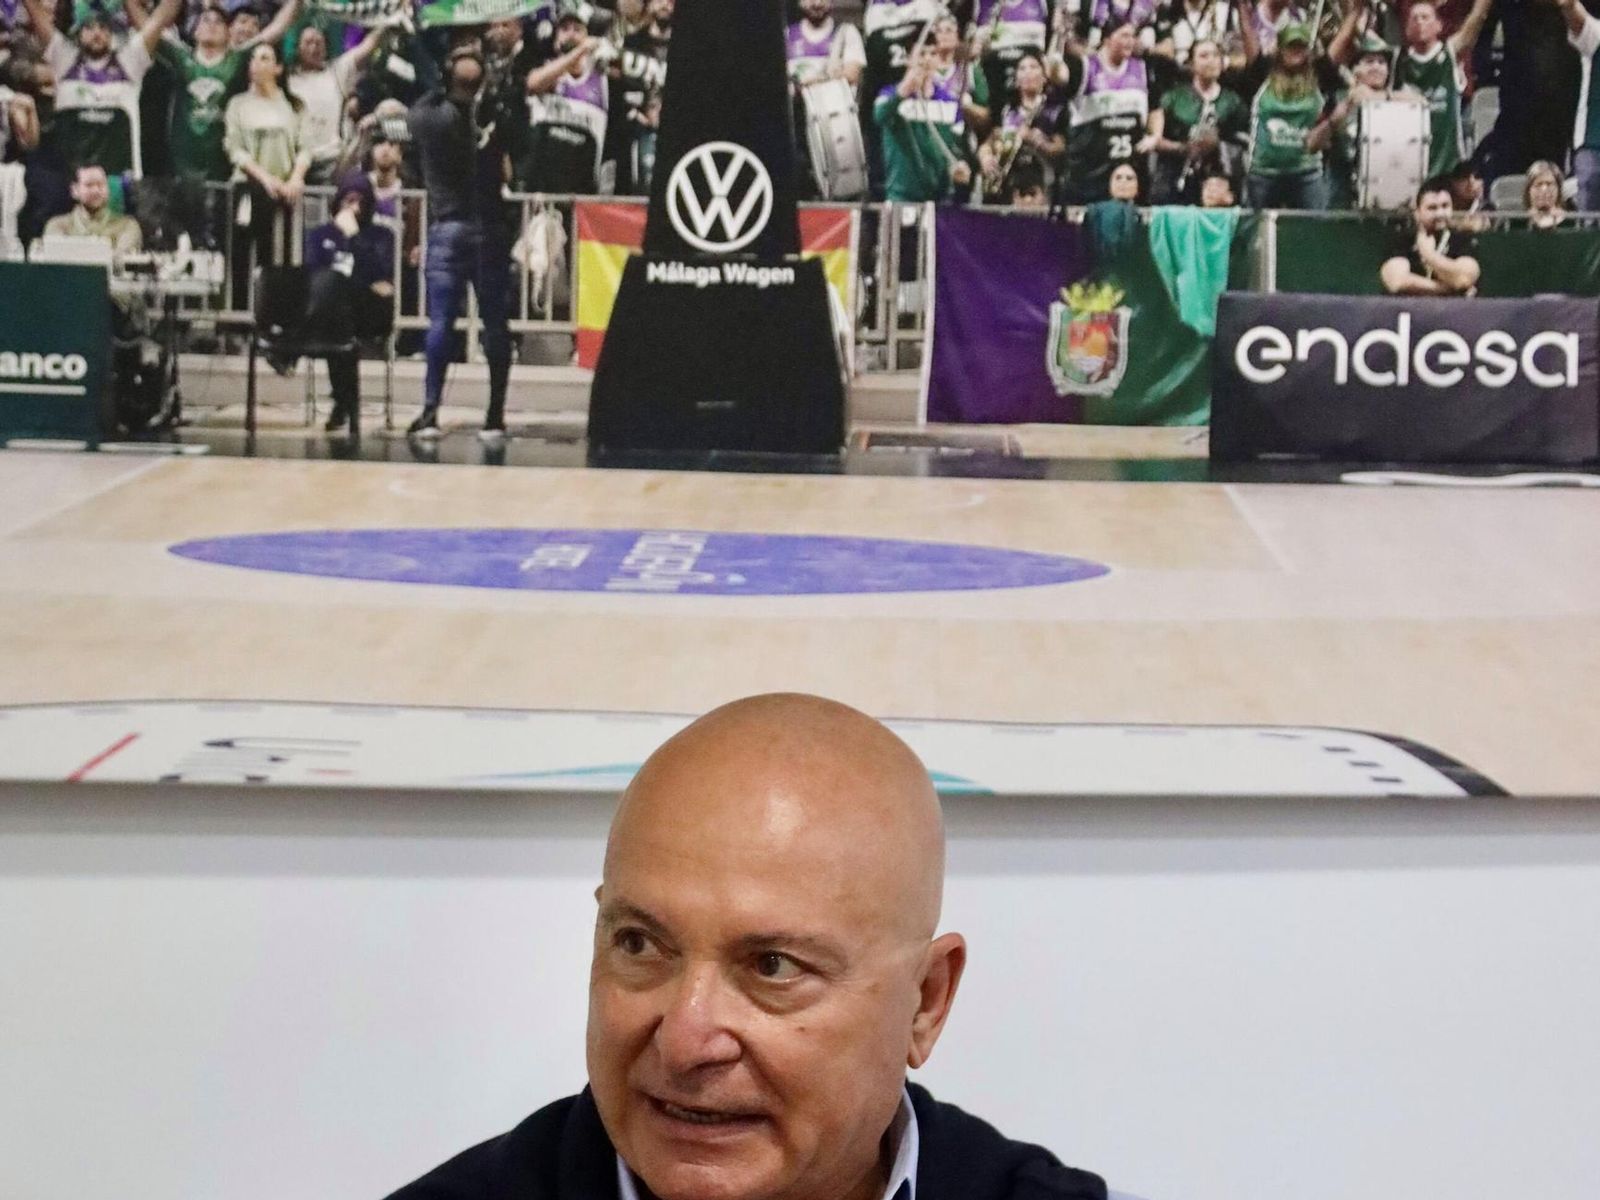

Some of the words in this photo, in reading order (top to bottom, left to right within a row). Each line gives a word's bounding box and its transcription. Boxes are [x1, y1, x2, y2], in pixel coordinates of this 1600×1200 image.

[647, 261, 721, 288] Málaga
[723, 262, 795, 288] Wagen
[1235, 312, 1579, 388] endesa
